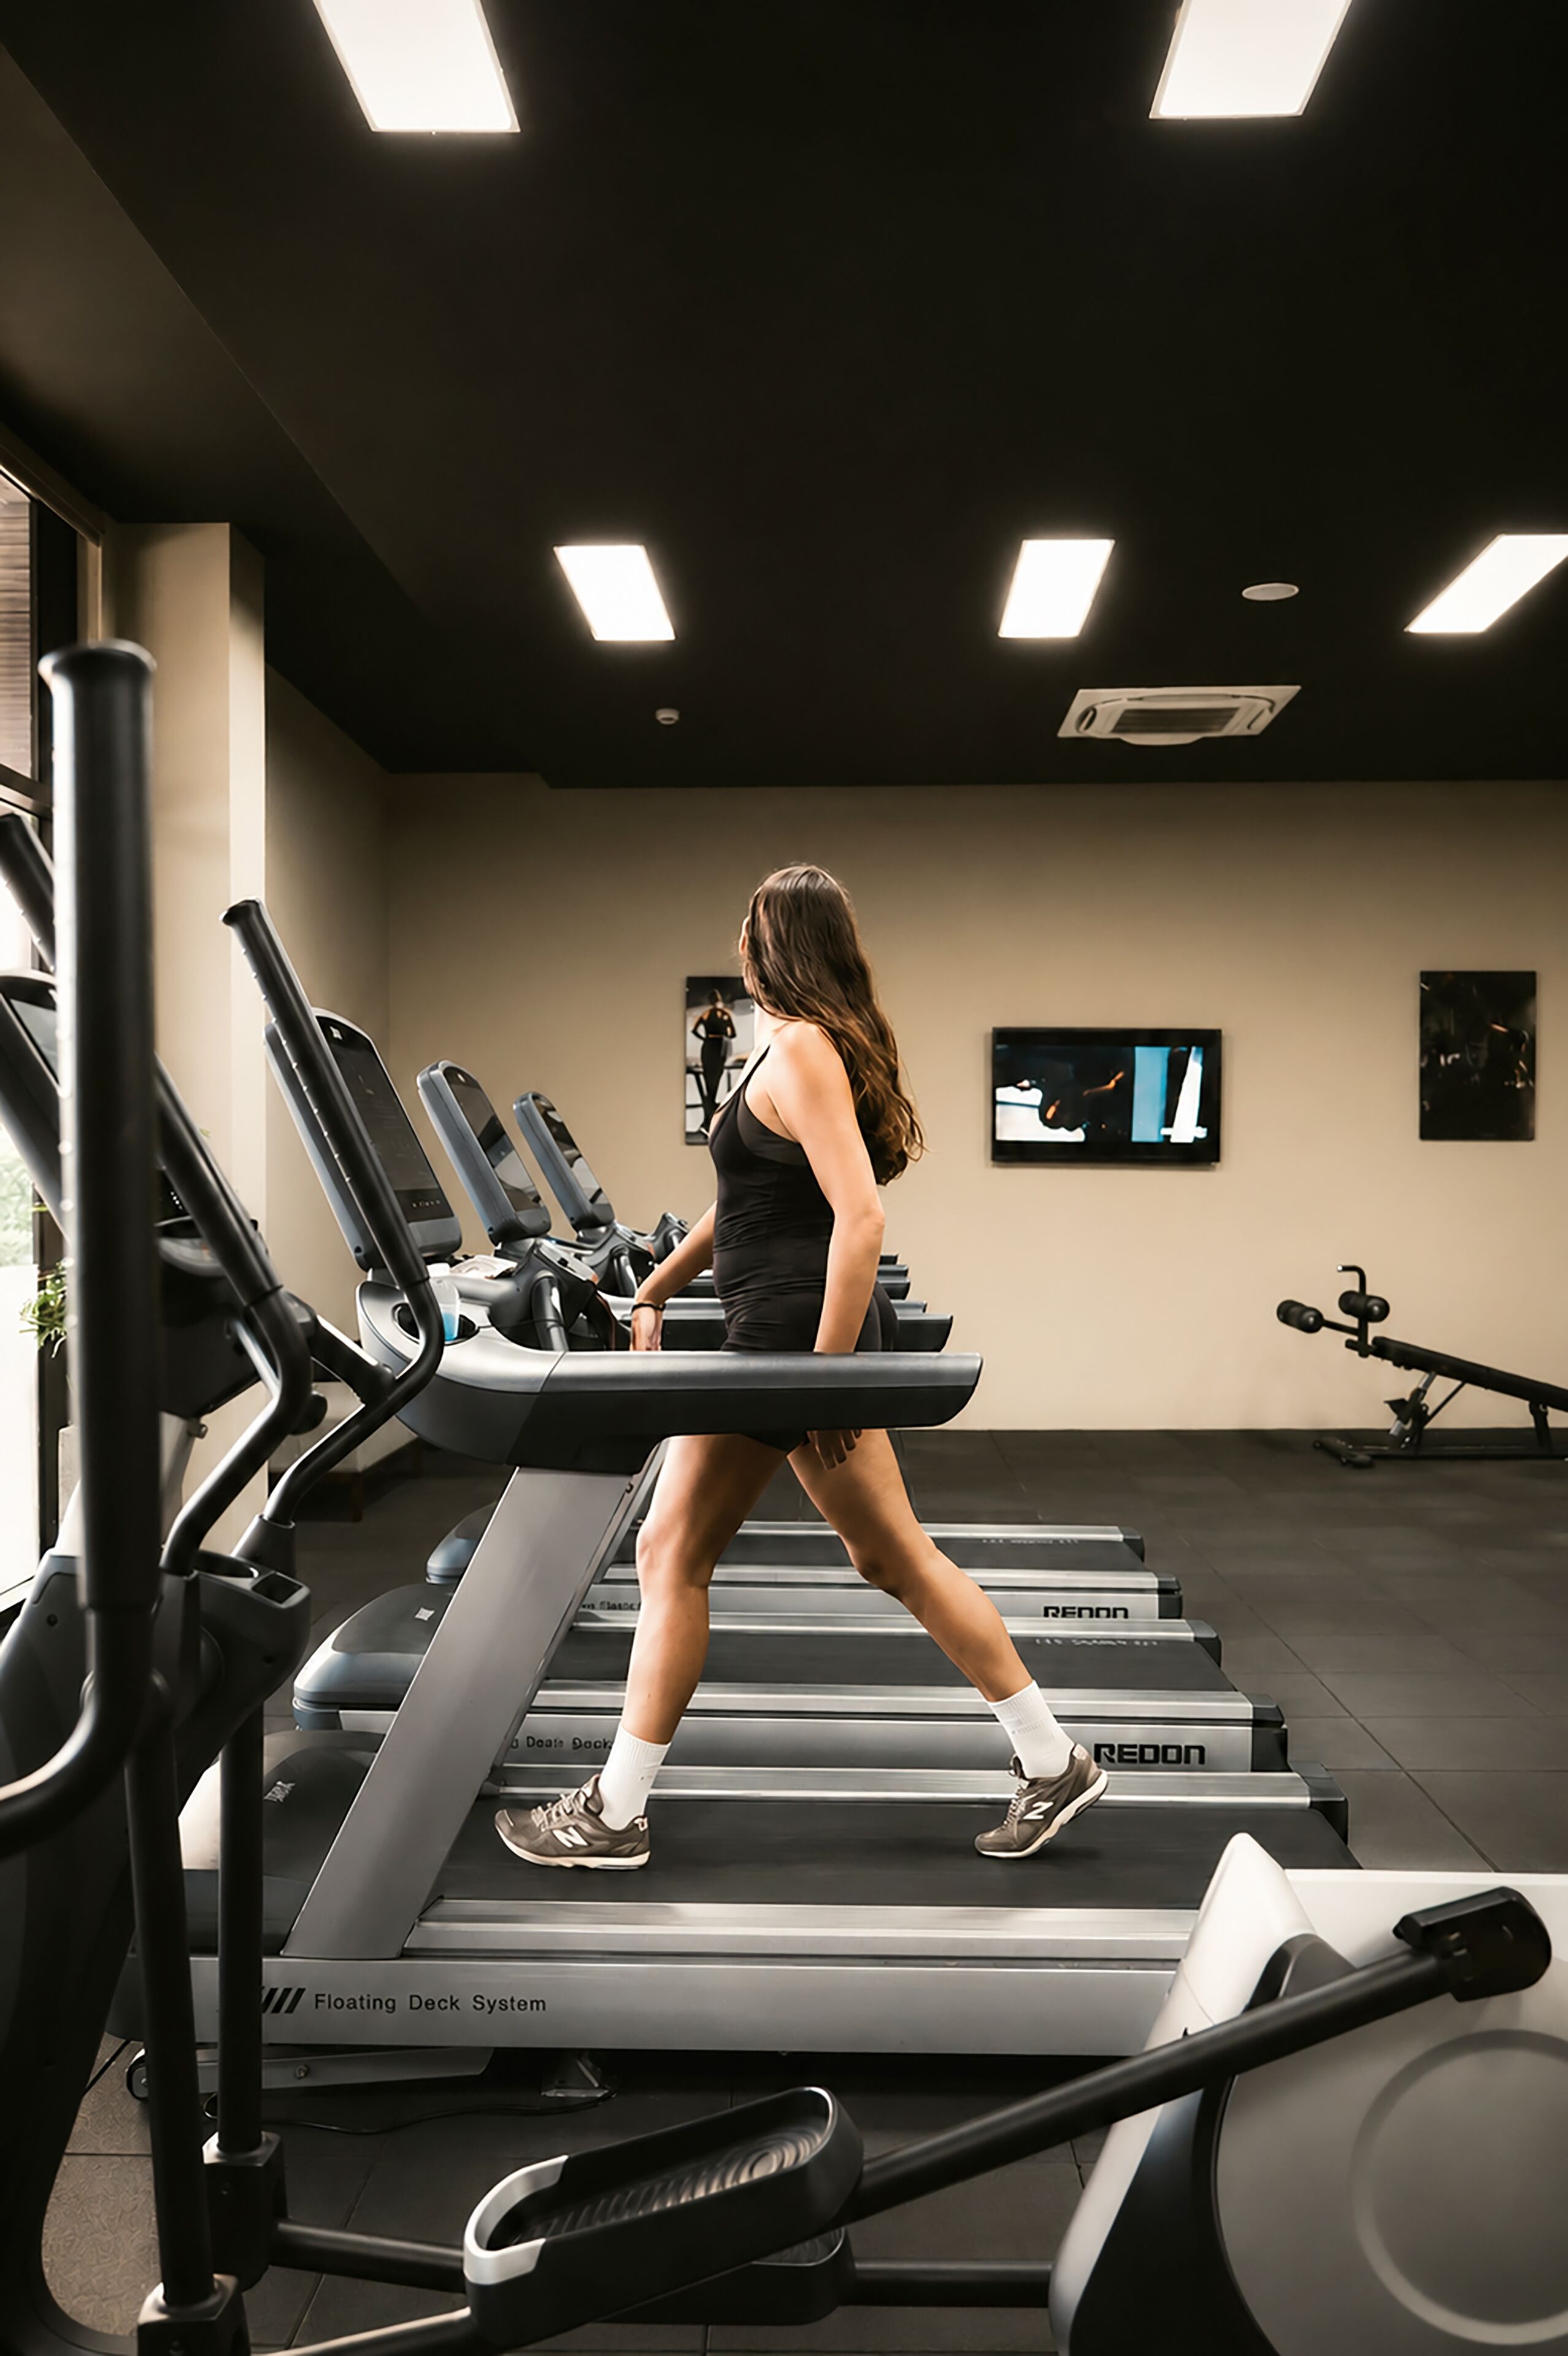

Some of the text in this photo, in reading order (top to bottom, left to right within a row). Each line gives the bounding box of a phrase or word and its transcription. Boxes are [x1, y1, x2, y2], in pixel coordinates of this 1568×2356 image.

[1093, 1743, 1205, 1765] REDON
[551, 1826, 590, 1848] N
[315, 1993, 546, 2014] Floating Deck System
